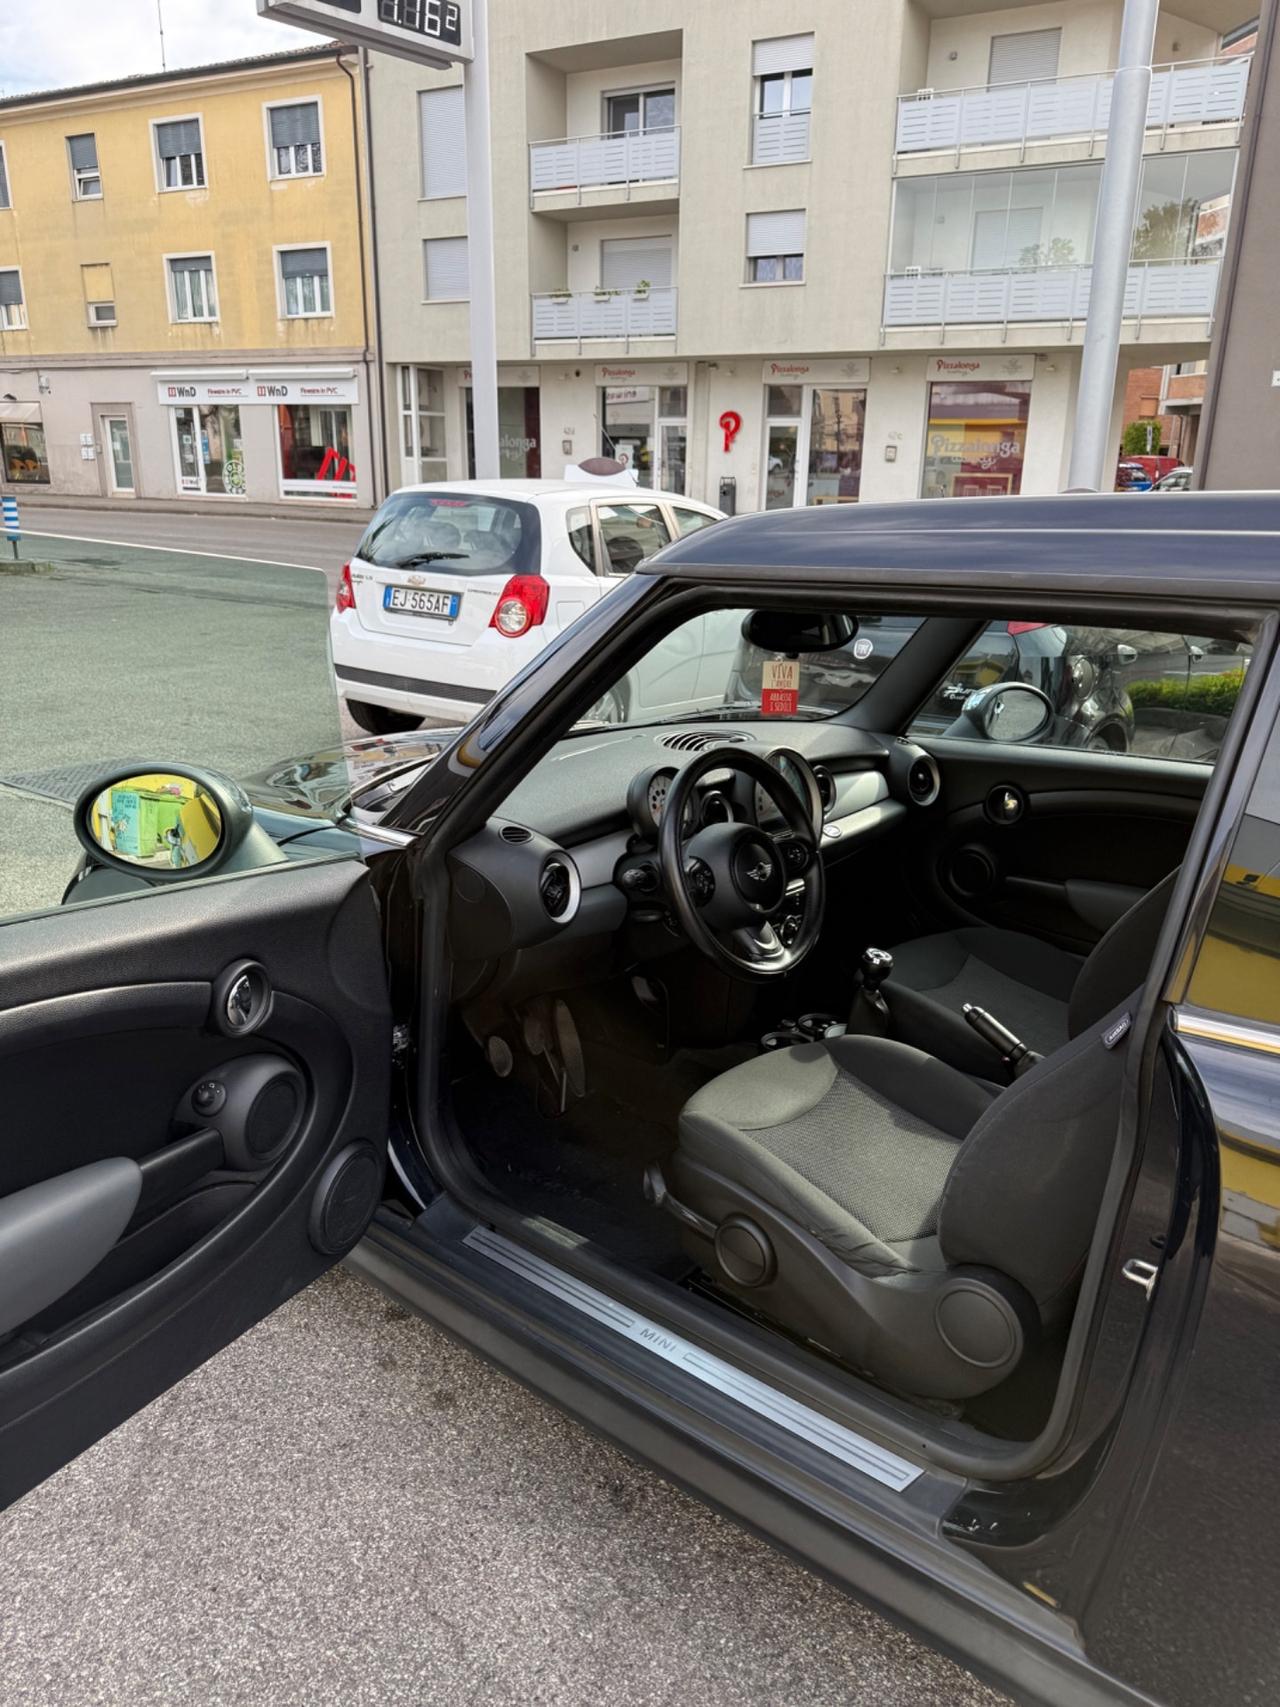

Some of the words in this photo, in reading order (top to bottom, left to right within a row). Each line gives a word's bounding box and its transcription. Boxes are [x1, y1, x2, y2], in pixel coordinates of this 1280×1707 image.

[177, 386, 197, 397] WnD
[267, 385, 288, 396] WnD
[391, 588, 408, 608] EJ
[411, 591, 450, 613] 565AF
[771, 665, 793, 679] VIVA
[640, 1327, 677, 1353] MINI
